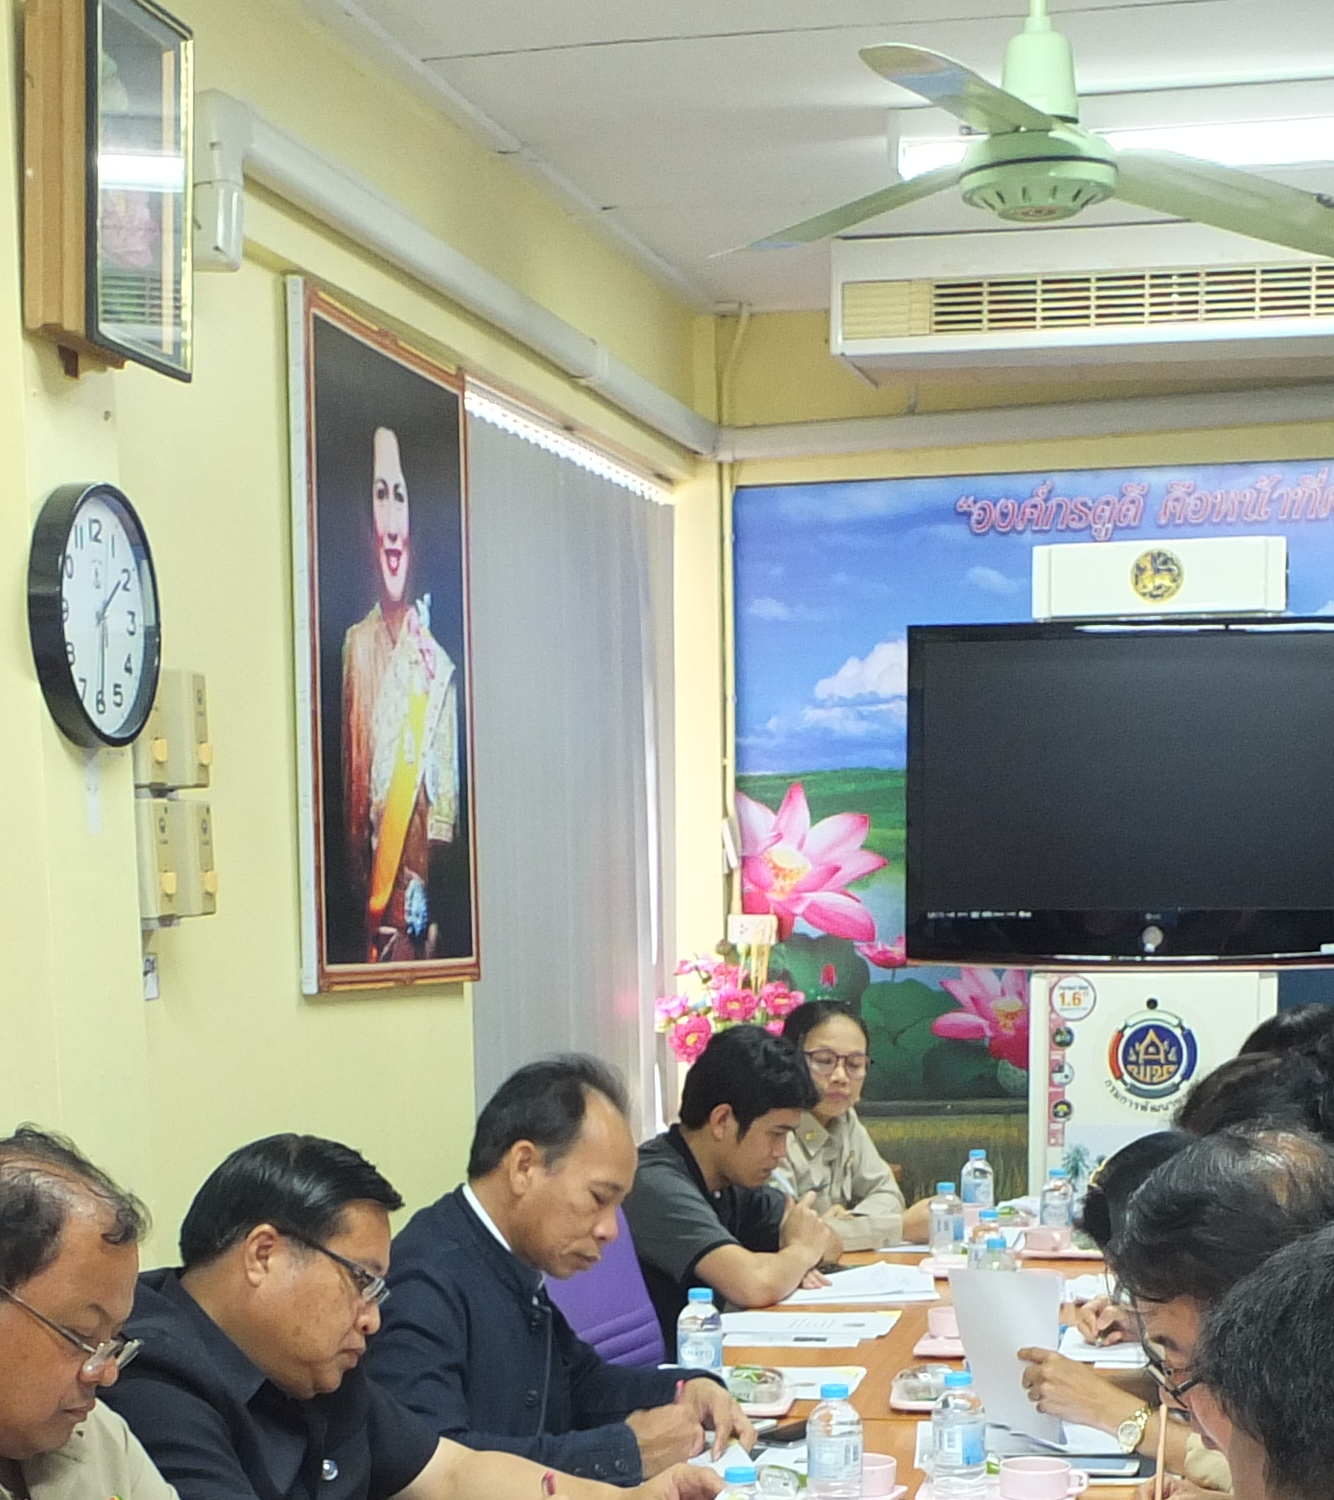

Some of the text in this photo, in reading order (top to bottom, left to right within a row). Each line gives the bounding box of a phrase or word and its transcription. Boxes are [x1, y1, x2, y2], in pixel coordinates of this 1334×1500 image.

[88, 517, 102, 543] 12
[121, 568, 131, 592] 2
[126, 610, 137, 637] 3
[123, 652, 133, 676] 4
[95, 689, 106, 716] 6
[112, 683, 124, 708] 5
